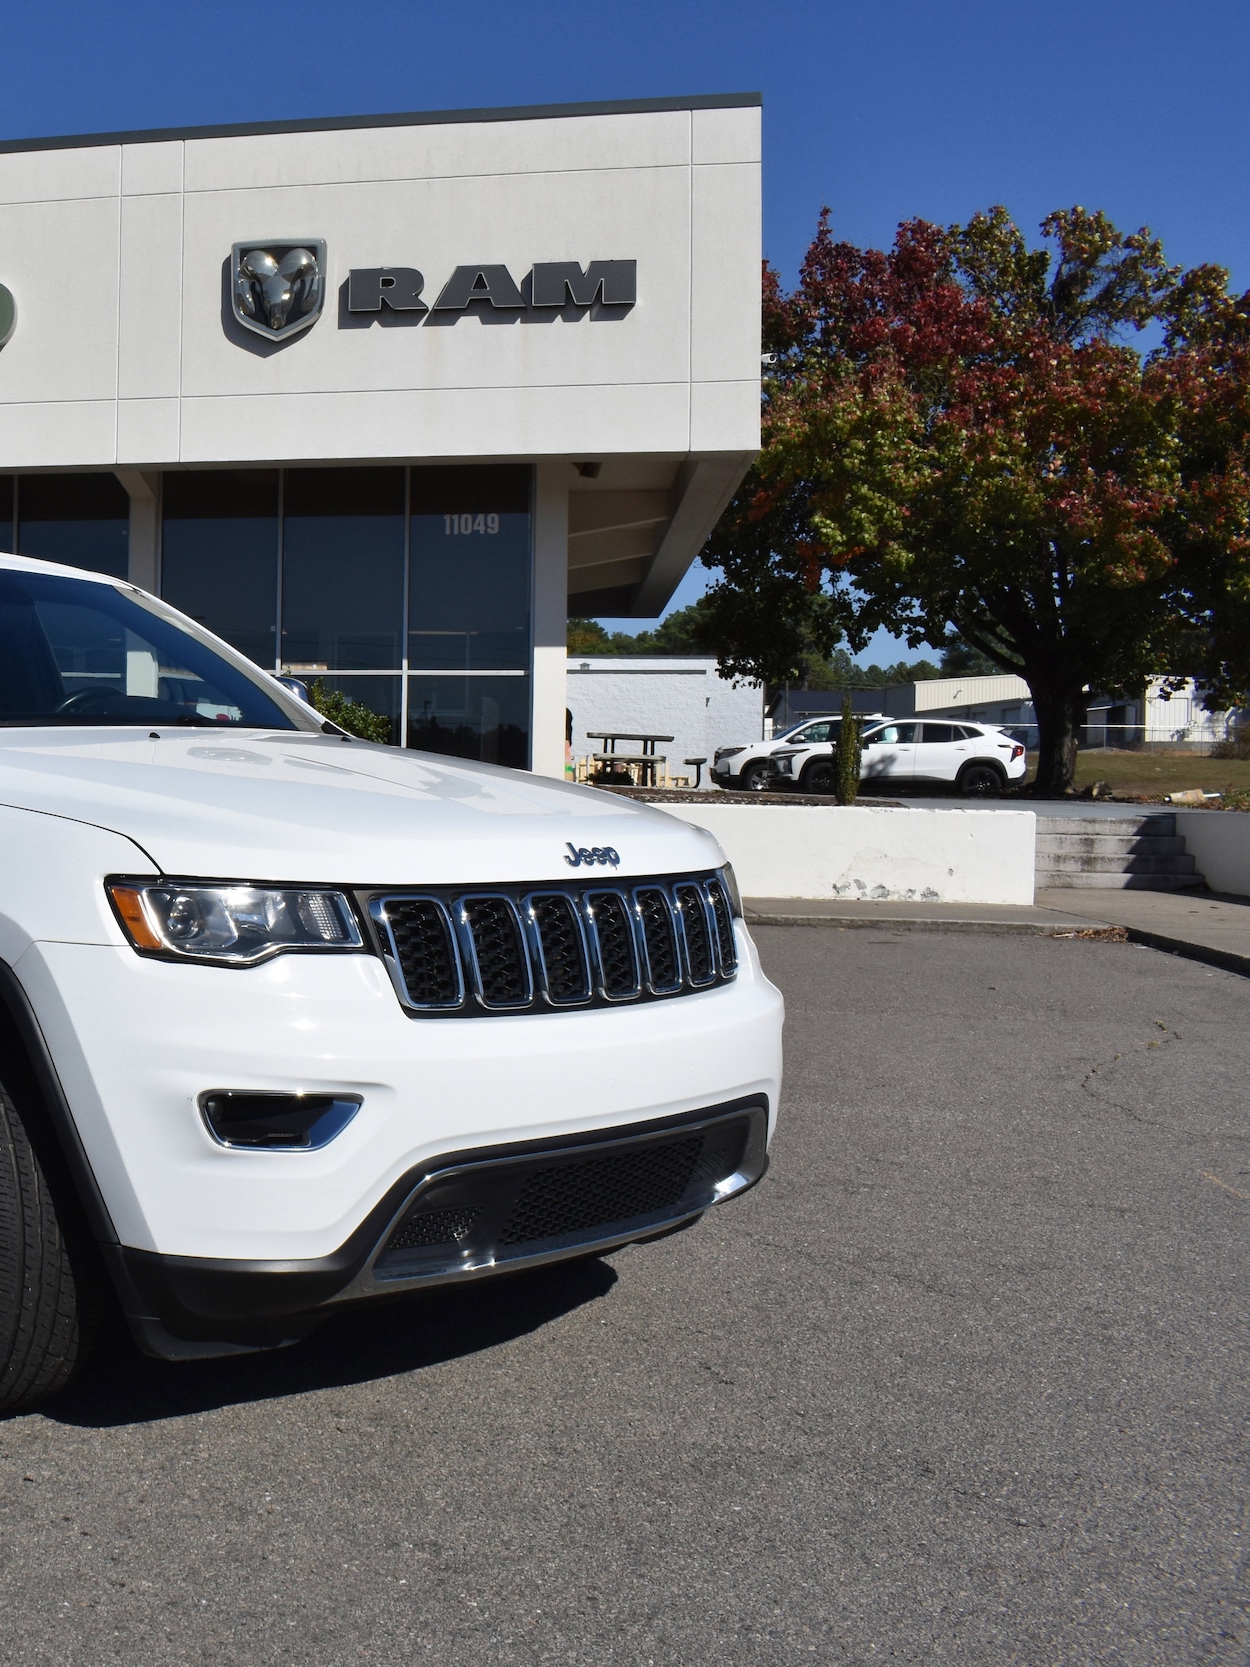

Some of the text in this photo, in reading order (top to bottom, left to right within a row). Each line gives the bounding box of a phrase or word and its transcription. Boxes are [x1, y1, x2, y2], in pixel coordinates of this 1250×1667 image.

[347, 259, 637, 312] RAM
[443, 513, 499, 535] 11049
[563, 842, 621, 870] Jeep
